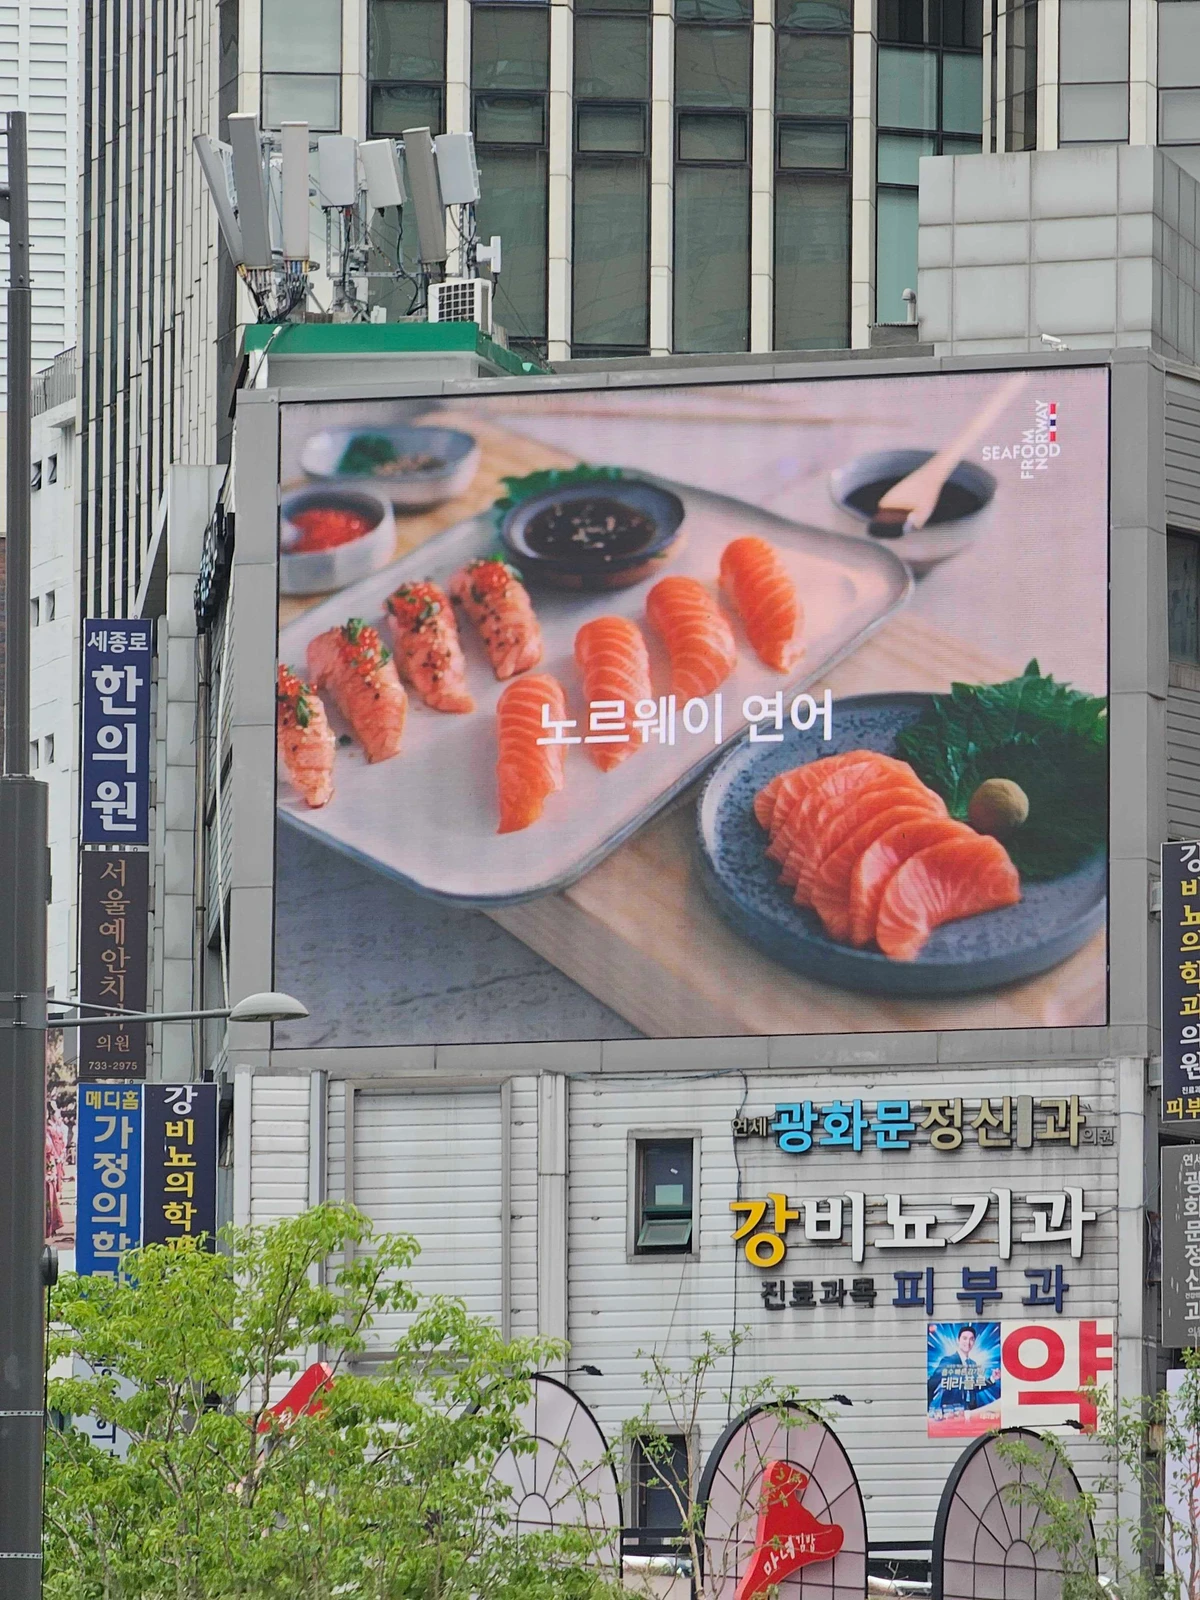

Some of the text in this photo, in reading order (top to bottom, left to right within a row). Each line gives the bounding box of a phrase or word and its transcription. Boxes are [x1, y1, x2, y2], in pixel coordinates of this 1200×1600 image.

[982, 443, 1061, 461] SEAFOOD
[87, 630, 149, 654] 세종로
[536, 688, 833, 746] 노르웨이 연어
[91, 664, 143, 832] 한의원
[96, 1034, 130, 1053] 의원
[88, 1061, 138, 1071] 733-2975
[85, 1090, 139, 1110] 메디홈
[731, 1116, 769, 1138] 연세
[729, 1186, 1097, 1268] 강비뇨기과
[760, 1264, 1070, 1316] 진료과목 피부과
[1002, 1320, 1114, 1434] 약
